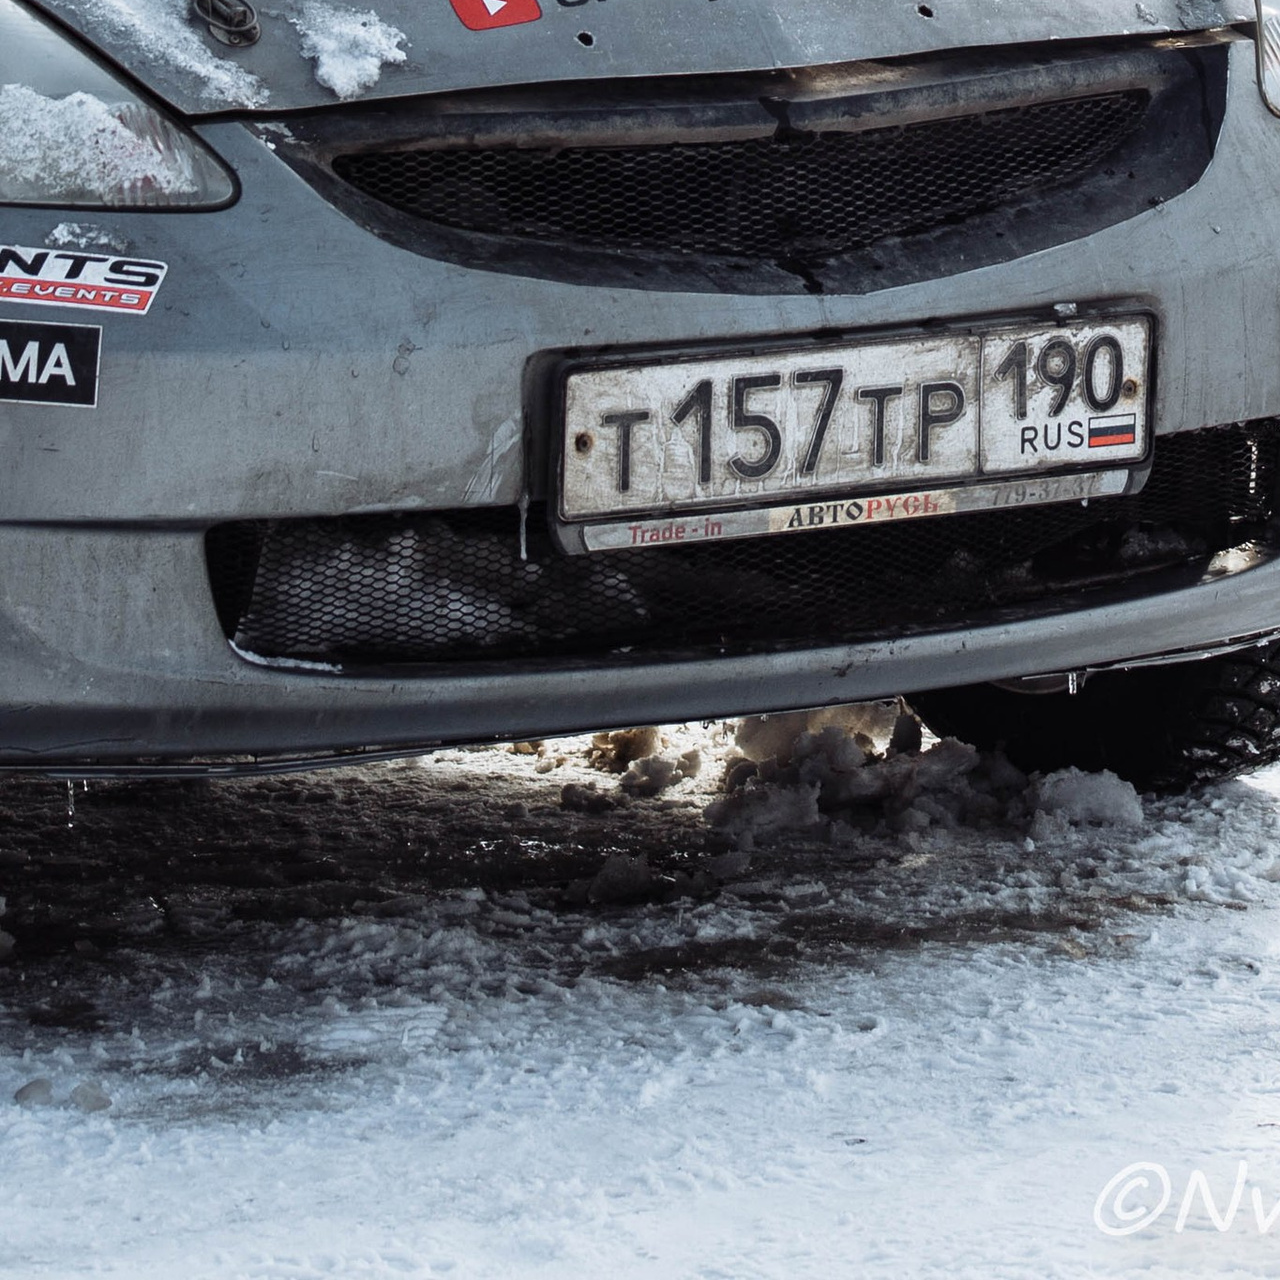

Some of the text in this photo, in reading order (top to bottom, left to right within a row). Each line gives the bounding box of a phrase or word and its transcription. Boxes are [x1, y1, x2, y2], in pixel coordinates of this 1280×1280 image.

[0, 282, 141, 305] EVENTS
[993, 334, 1124, 420] 190
[601, 367, 966, 493] Т157ТР
[1020, 420, 1085, 455] RUS
[628, 523, 685, 545] Trade
[704, 518, 723, 536] in
